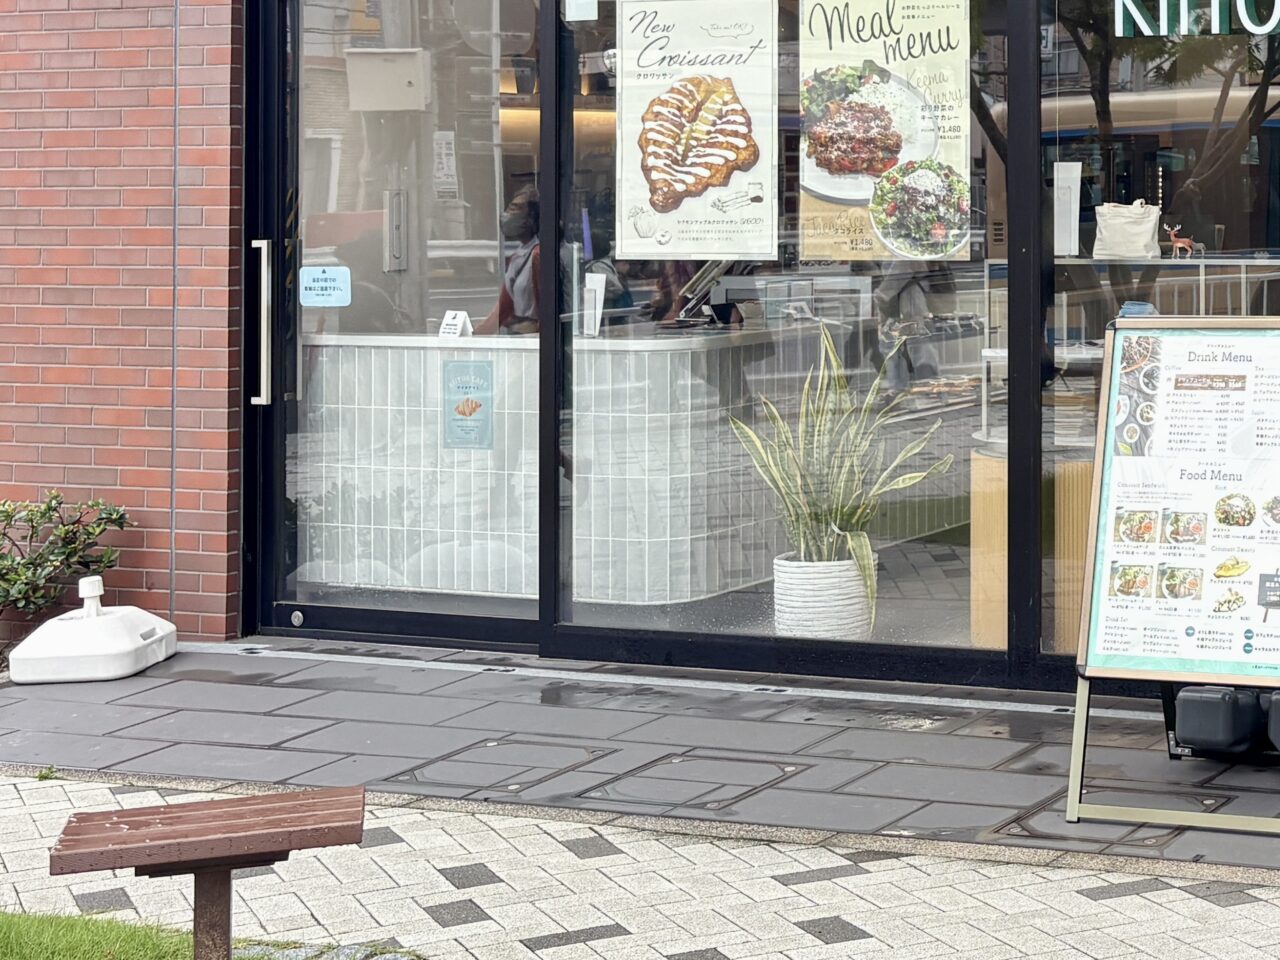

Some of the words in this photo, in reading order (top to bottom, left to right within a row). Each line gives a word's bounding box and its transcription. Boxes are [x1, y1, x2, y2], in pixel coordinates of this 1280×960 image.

[629, 10, 676, 39] New
[637, 35, 767, 68] Croissant
[883, 25, 960, 65] menu
[636, 72, 674, 80] クロワッサン
[906, 68, 948, 91] Keema
[923, 87, 964, 108] Curry
[1188, 351, 1218, 362] Drink
[1221, 351, 1253, 362] Menu
[1179, 469, 1207, 480] Food
[1210, 470, 1242, 481] Menu
